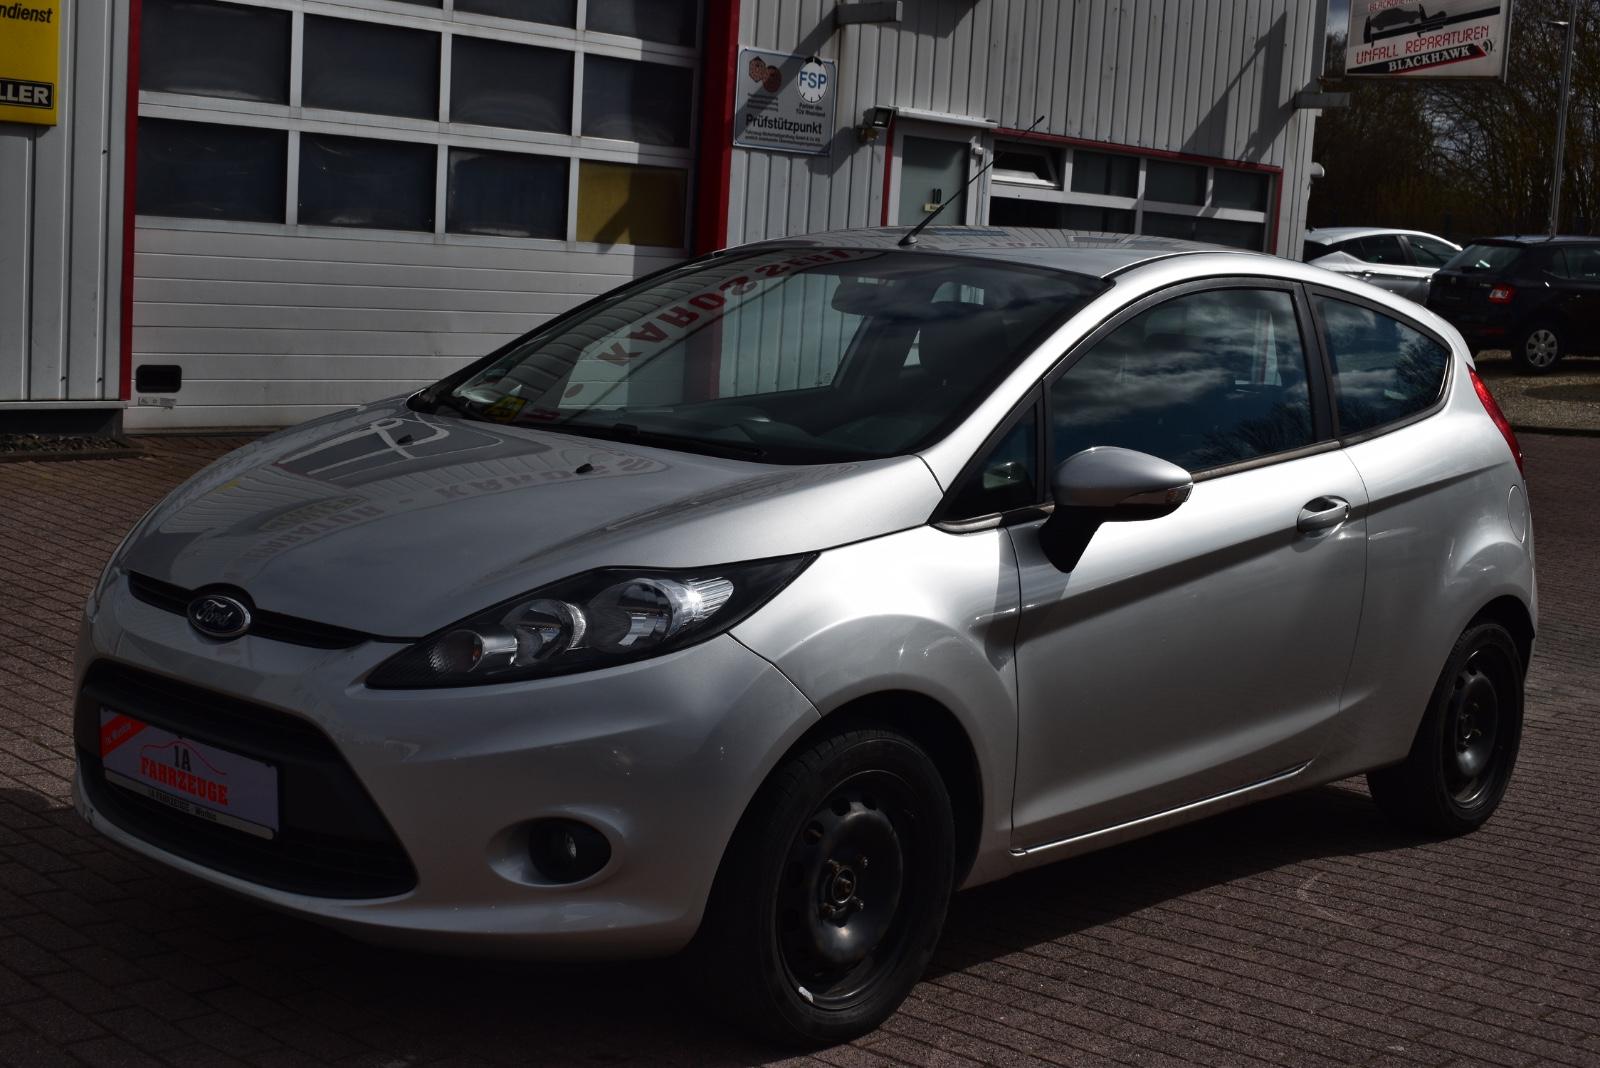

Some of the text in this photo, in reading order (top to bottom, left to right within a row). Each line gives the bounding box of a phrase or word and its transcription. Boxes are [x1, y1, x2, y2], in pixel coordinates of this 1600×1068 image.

[1356, 25, 1490, 64] UNFALL REPARATUREN
[1388, 46, 1470, 72] BLACKHAWK
[800, 71, 827, 89] FSP
[745, 114, 822, 135] Prüfstützpunkt
[140, 756, 229, 806] FAHRZEUGE
